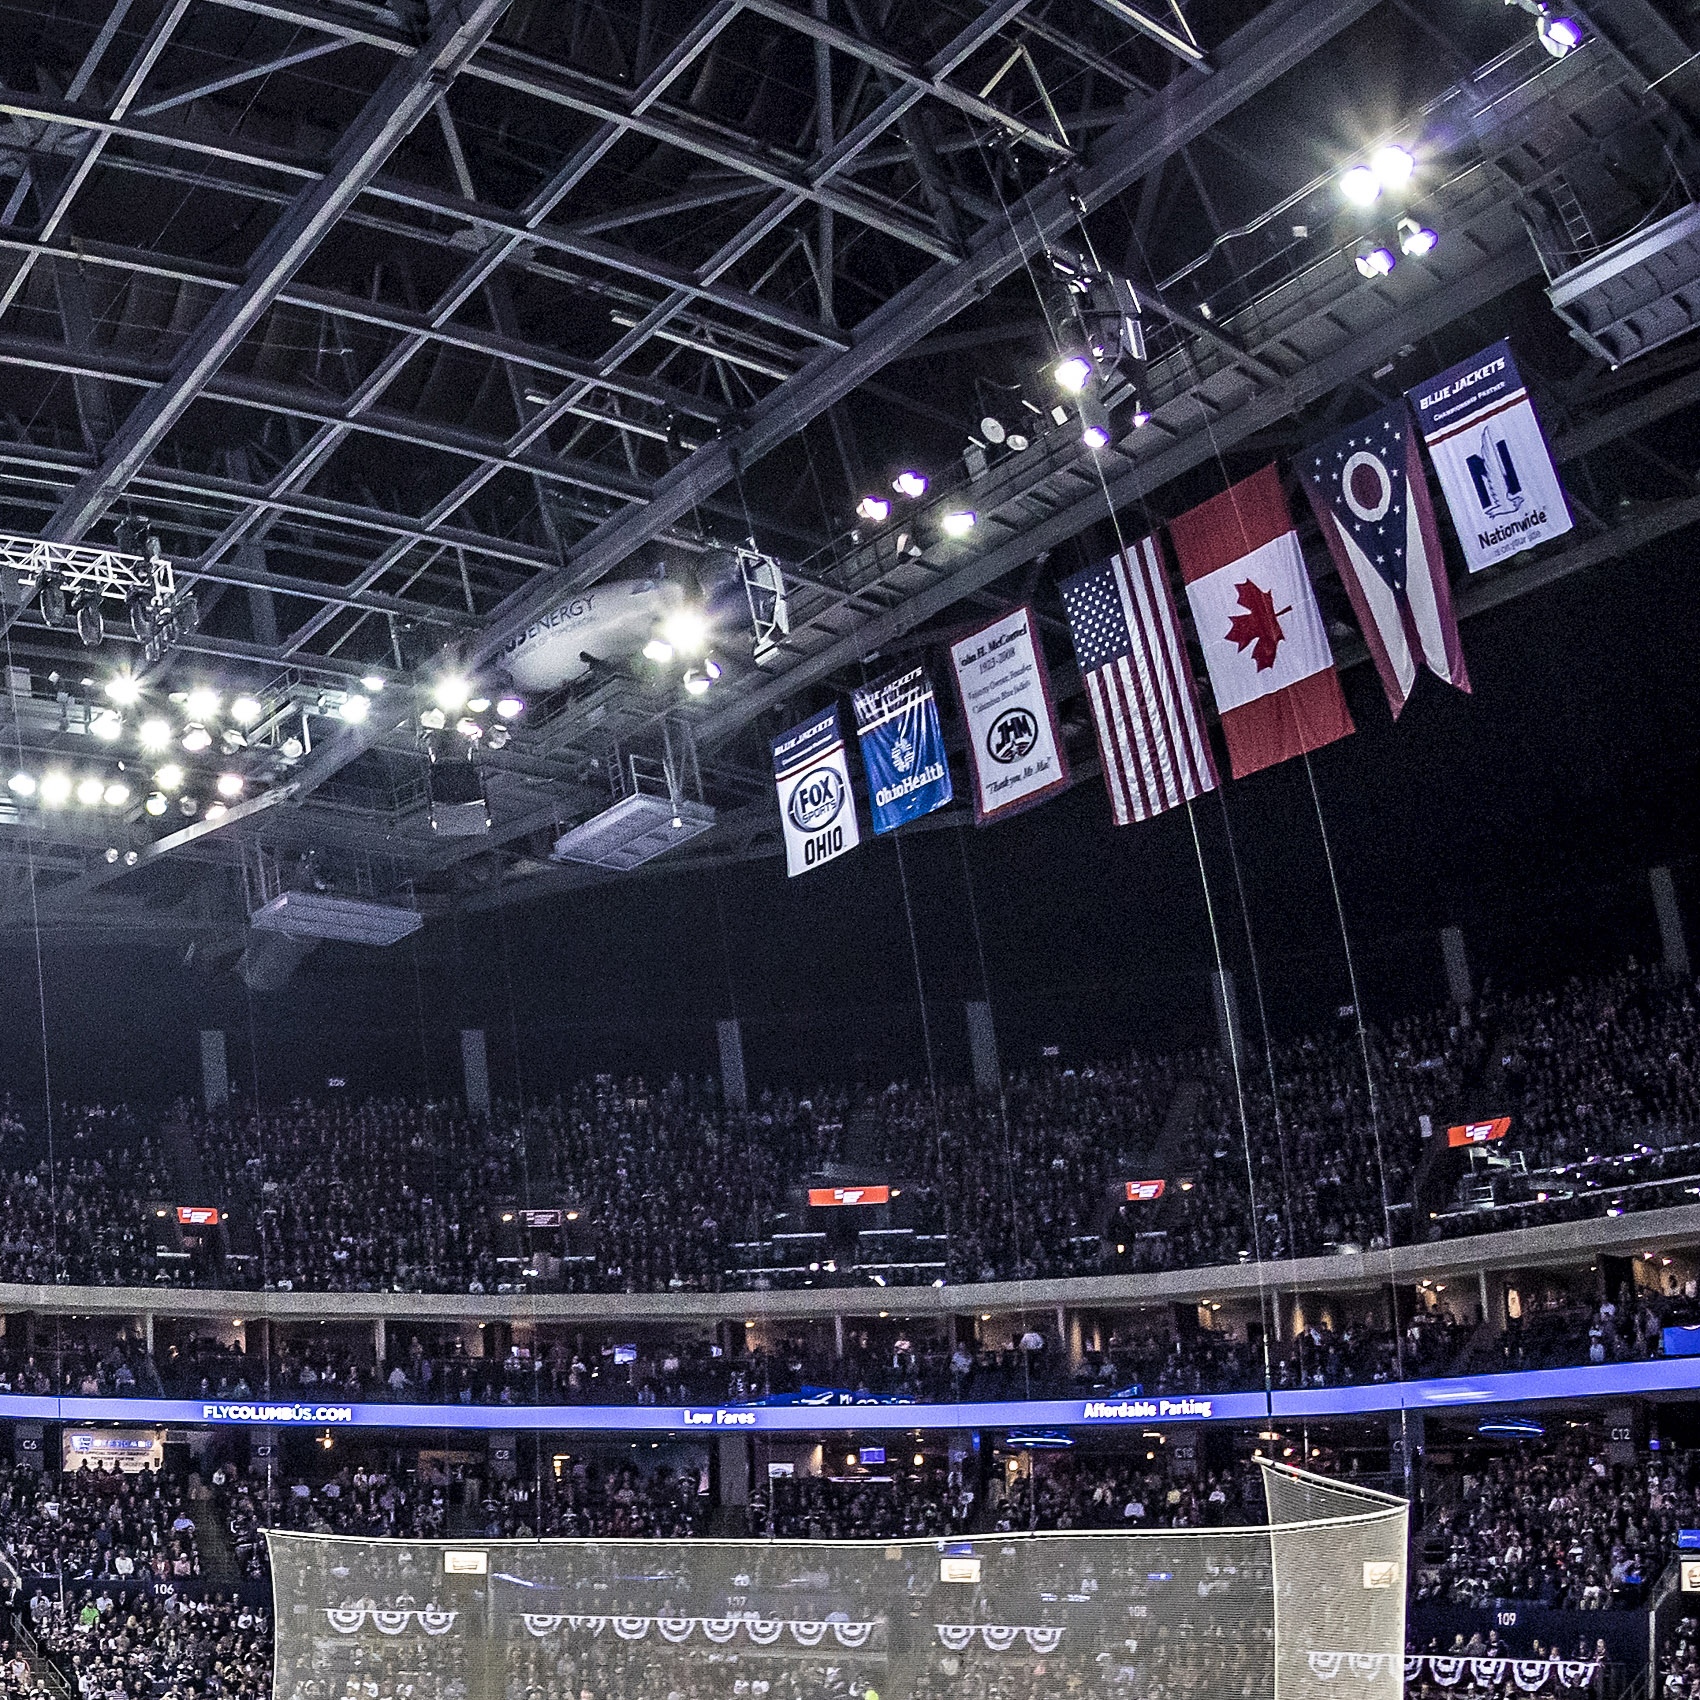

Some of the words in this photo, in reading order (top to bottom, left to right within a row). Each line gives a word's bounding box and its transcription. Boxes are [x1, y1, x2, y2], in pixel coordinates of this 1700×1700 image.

[1420, 385, 1451, 410] BLUE
[1452, 357, 1506, 395] JACKETS
[1478, 510, 1547, 550] Nationwide
[798, 715, 836, 744] JACKETS
[996, 715, 1032, 749] JHM
[800, 776, 835, 814] FOX
[876, 762, 946, 808] OhioHealth
[802, 800, 838, 824] SPORTS
[804, 825, 843, 867] OHIO
[203, 1404, 352, 1422] FLYCOLUMBUS.COM
[684, 1410, 714, 1424] Low
[716, 1410, 756, 1424] Fares
[1084, 1402, 1157, 1418] Affordable
[1159, 1400, 1212, 1418] Parking
[153, 1584, 175, 1595] 106
[1497, 1612, 1517, 1626] 109
